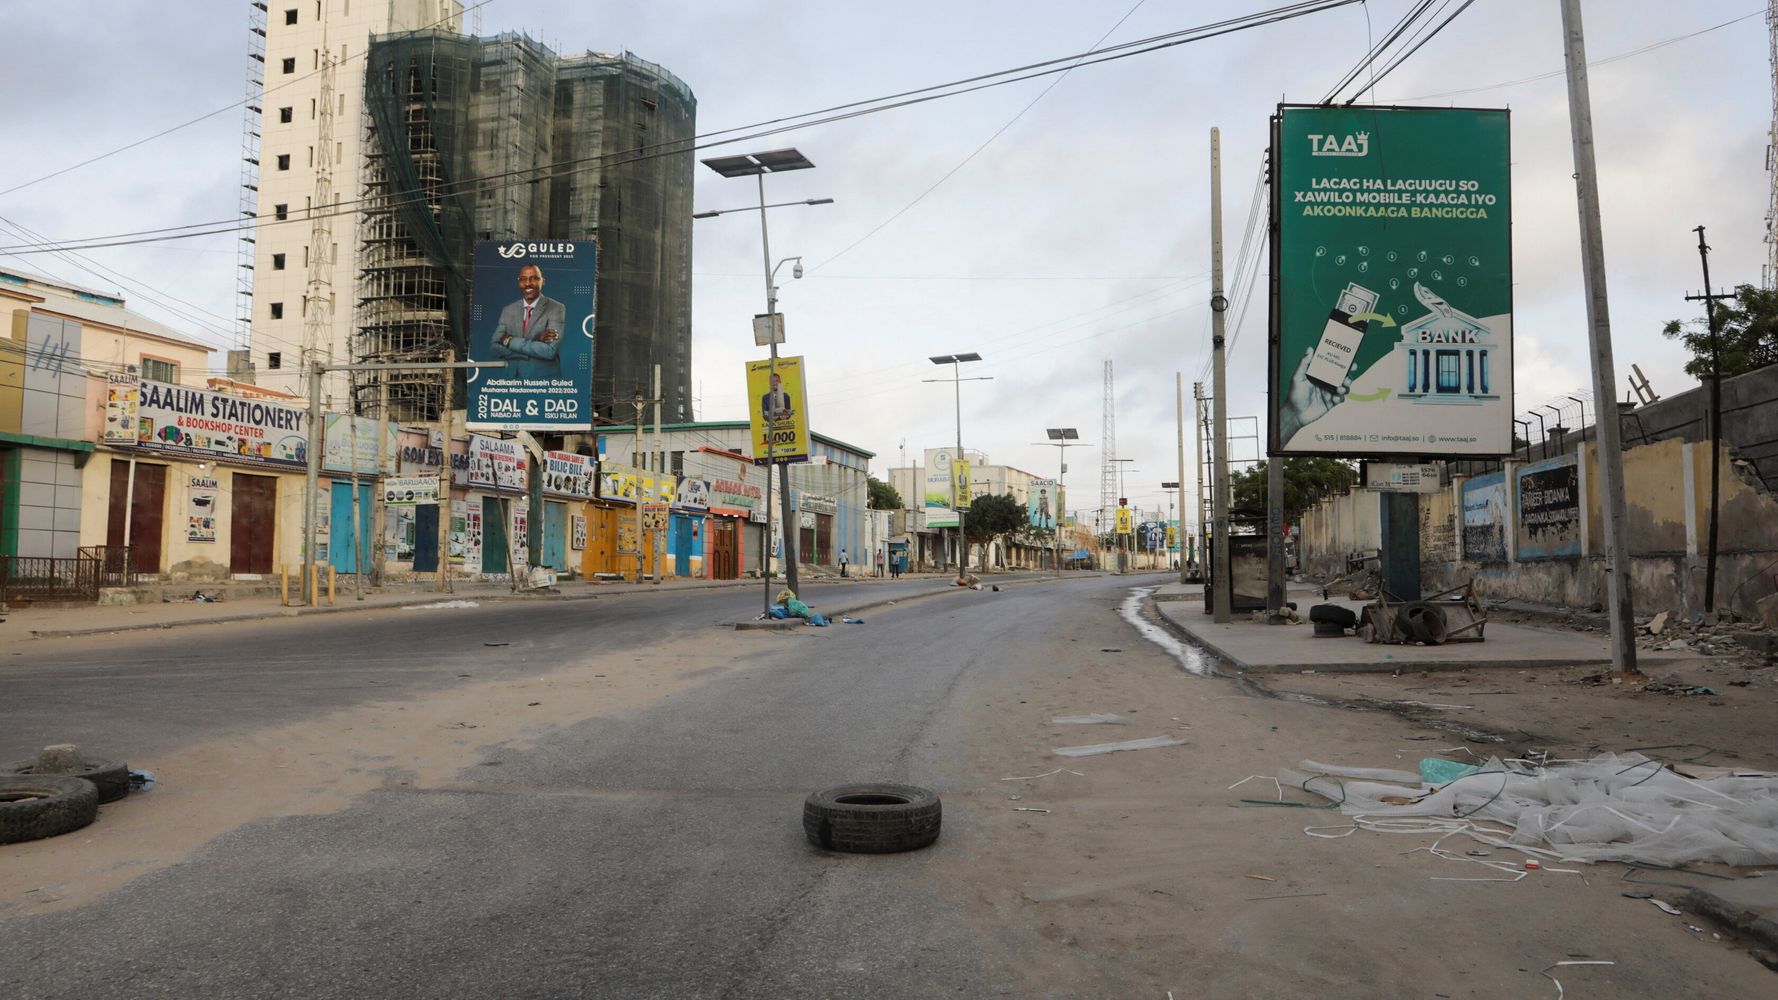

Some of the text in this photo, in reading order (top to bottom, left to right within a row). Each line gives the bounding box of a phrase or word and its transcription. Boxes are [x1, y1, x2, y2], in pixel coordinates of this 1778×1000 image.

[1308, 132, 1368, 156] TAAJ
[1311, 178, 1479, 191] LACAG HA LAGUUGU SO
[1294, 191, 1496, 205] XAWILO MOBILE-KAAGA IYO
[1303, 205, 1488, 219] AKOONKAAGA BANGIGGA
[528, 243, 575, 253] GULED
[1417, 328, 1480, 344] BANK
[1325, 338, 1352, 353] RECIEVED
[108, 373, 138, 385] SAALIM
[140, 383, 303, 432] SAALIM STATIONERY
[478, 394, 488, 419] 2022
[490, 399, 578, 416] DAL & DAD
[177, 416, 265, 439] & BOOKSHOP CENTER
[480, 439, 515, 455] SALAAMA
[549, 460, 583, 476] BILIC BILE
[191, 478, 218, 489] SAALIM
